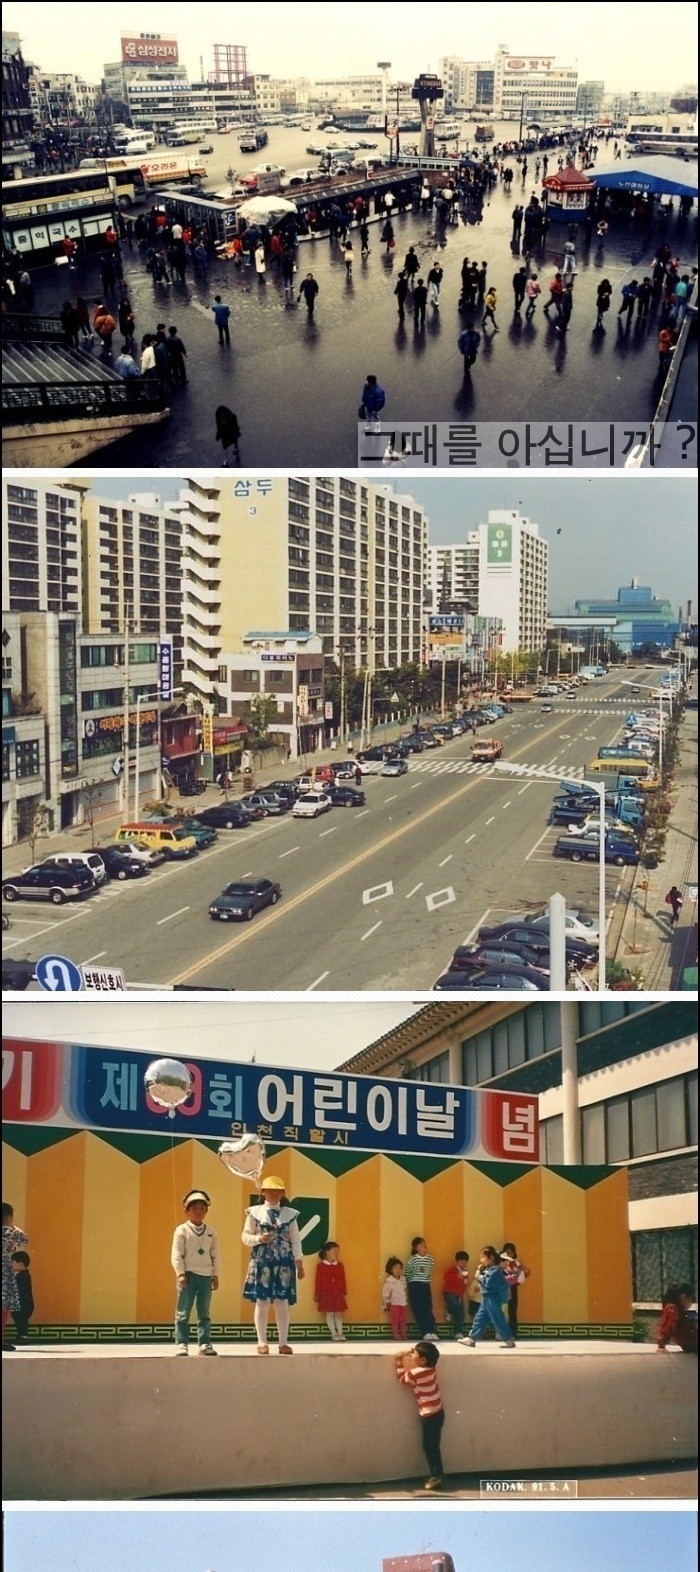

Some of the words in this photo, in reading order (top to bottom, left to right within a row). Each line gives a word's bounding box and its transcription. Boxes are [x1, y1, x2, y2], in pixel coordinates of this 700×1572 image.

[138, 45, 178, 57] 삼성전자
[151, 162, 177, 172] 오리온
[233, 478, 272, 498] 삼두
[248, 506, 257, 516] 3
[84, 971, 123, 990] 보행신호시
[100, 1061, 242, 1121] 제9회
[257, 1074, 459, 1139] 어린이날
[502, 1101, 535, 1154] 념
[230, 1122, 348, 1145] 인천직할시
